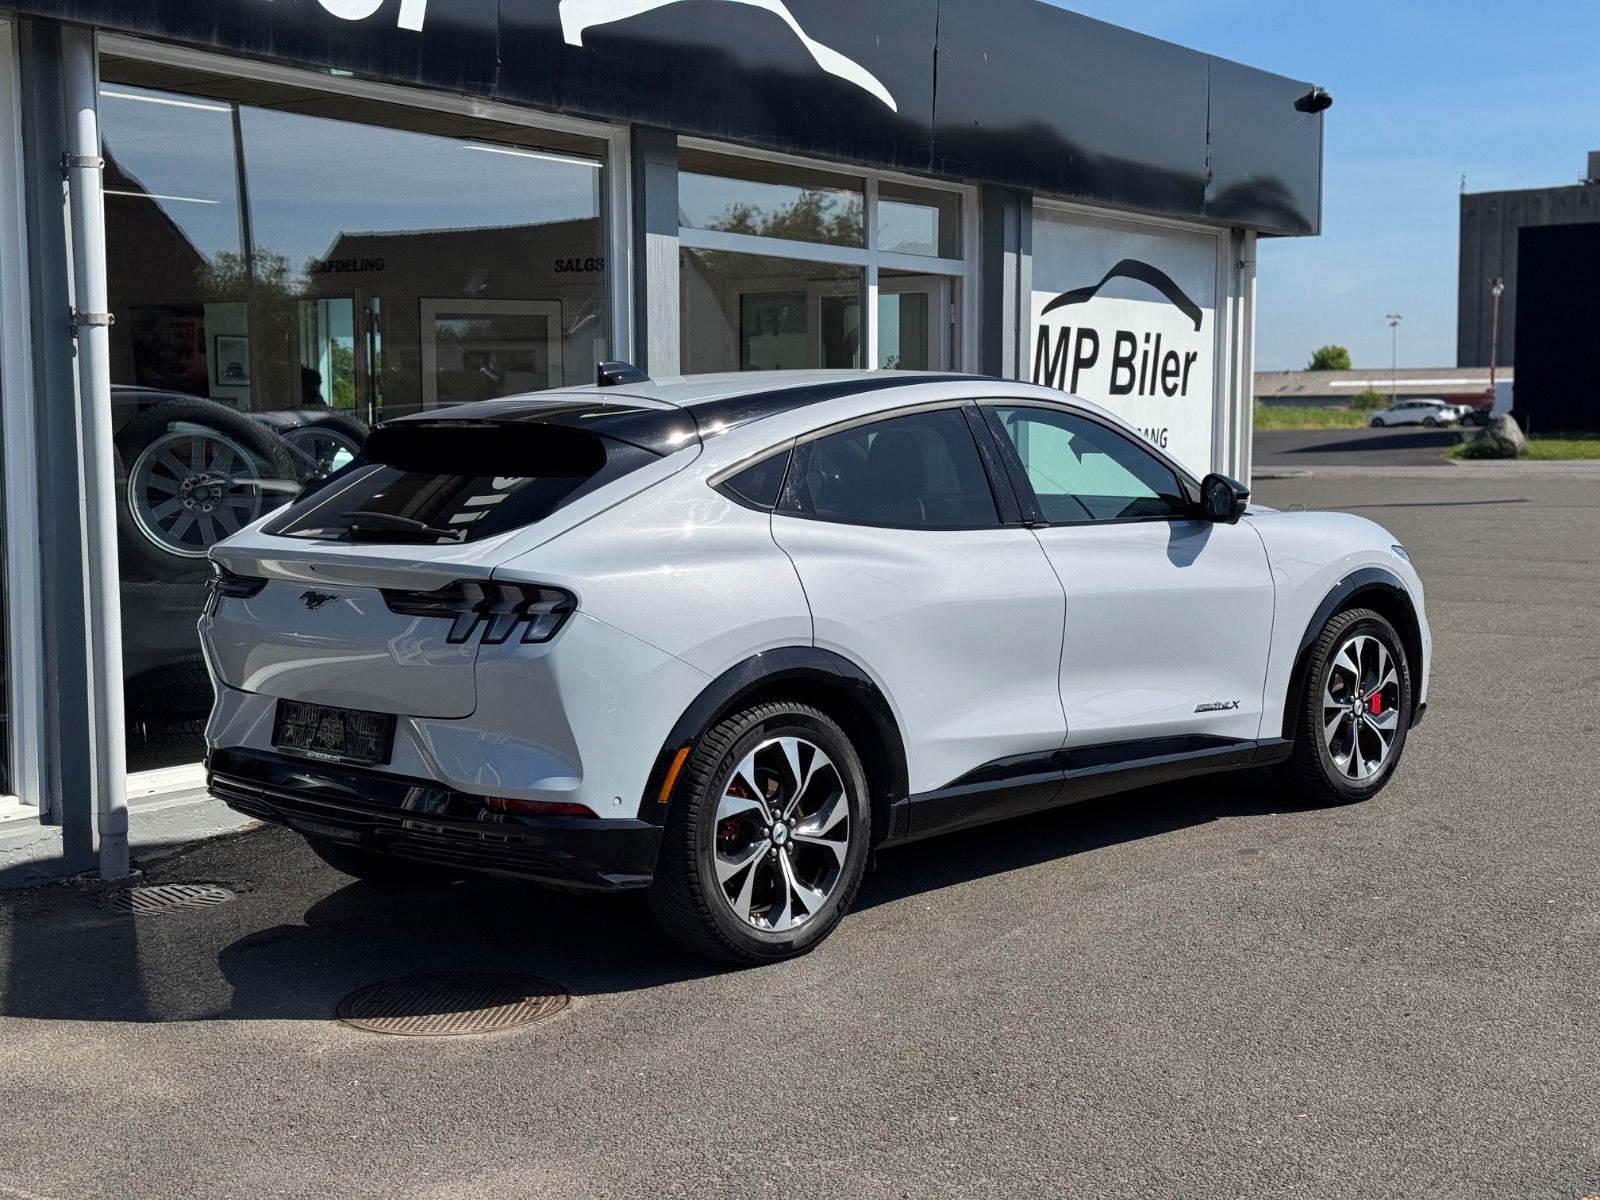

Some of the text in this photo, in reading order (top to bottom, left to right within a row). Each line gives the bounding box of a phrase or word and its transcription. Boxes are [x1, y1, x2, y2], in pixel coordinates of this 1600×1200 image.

[314, 257, 385, 274] AFDELING
[1033, 324, 1198, 397] MP Biler
[1136, 427, 1169, 449] ANG
